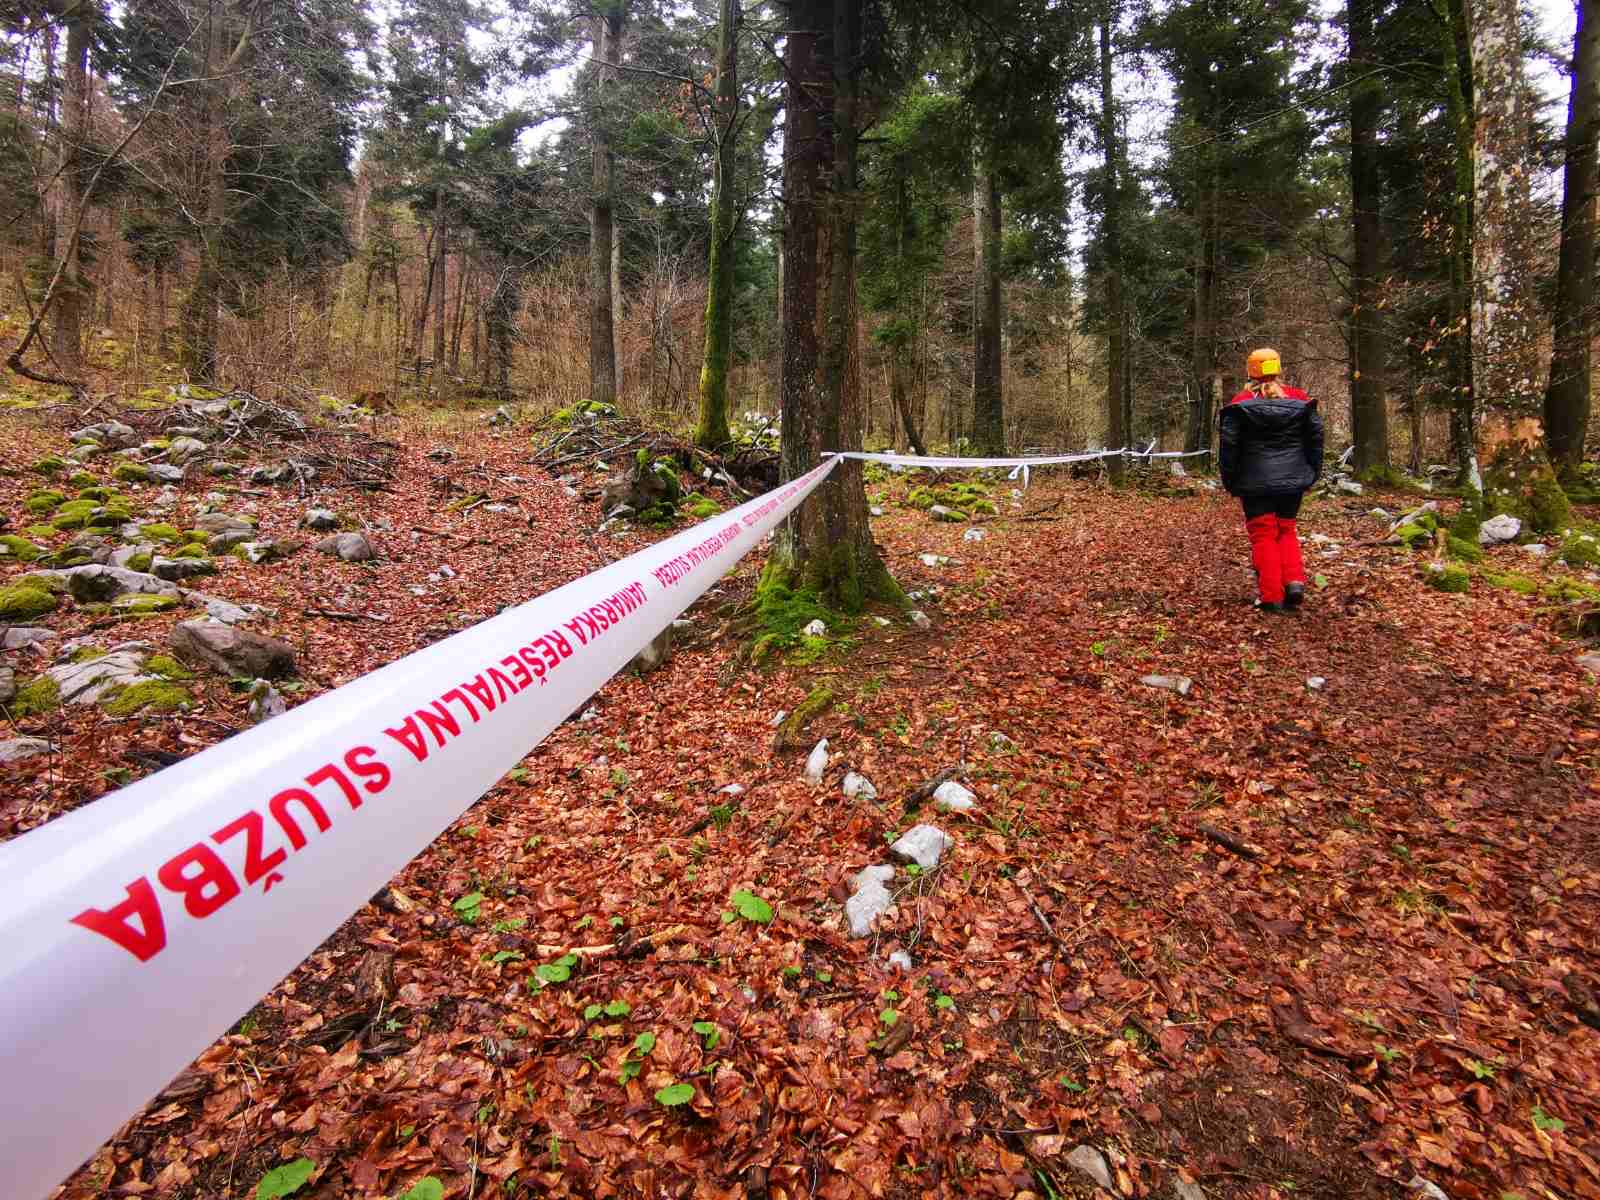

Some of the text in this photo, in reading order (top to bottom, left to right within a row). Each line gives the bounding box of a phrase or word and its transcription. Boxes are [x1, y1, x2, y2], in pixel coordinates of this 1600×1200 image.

[70, 581, 648, 962] JAMARSKA REŠEVALNA SLUŽBA
